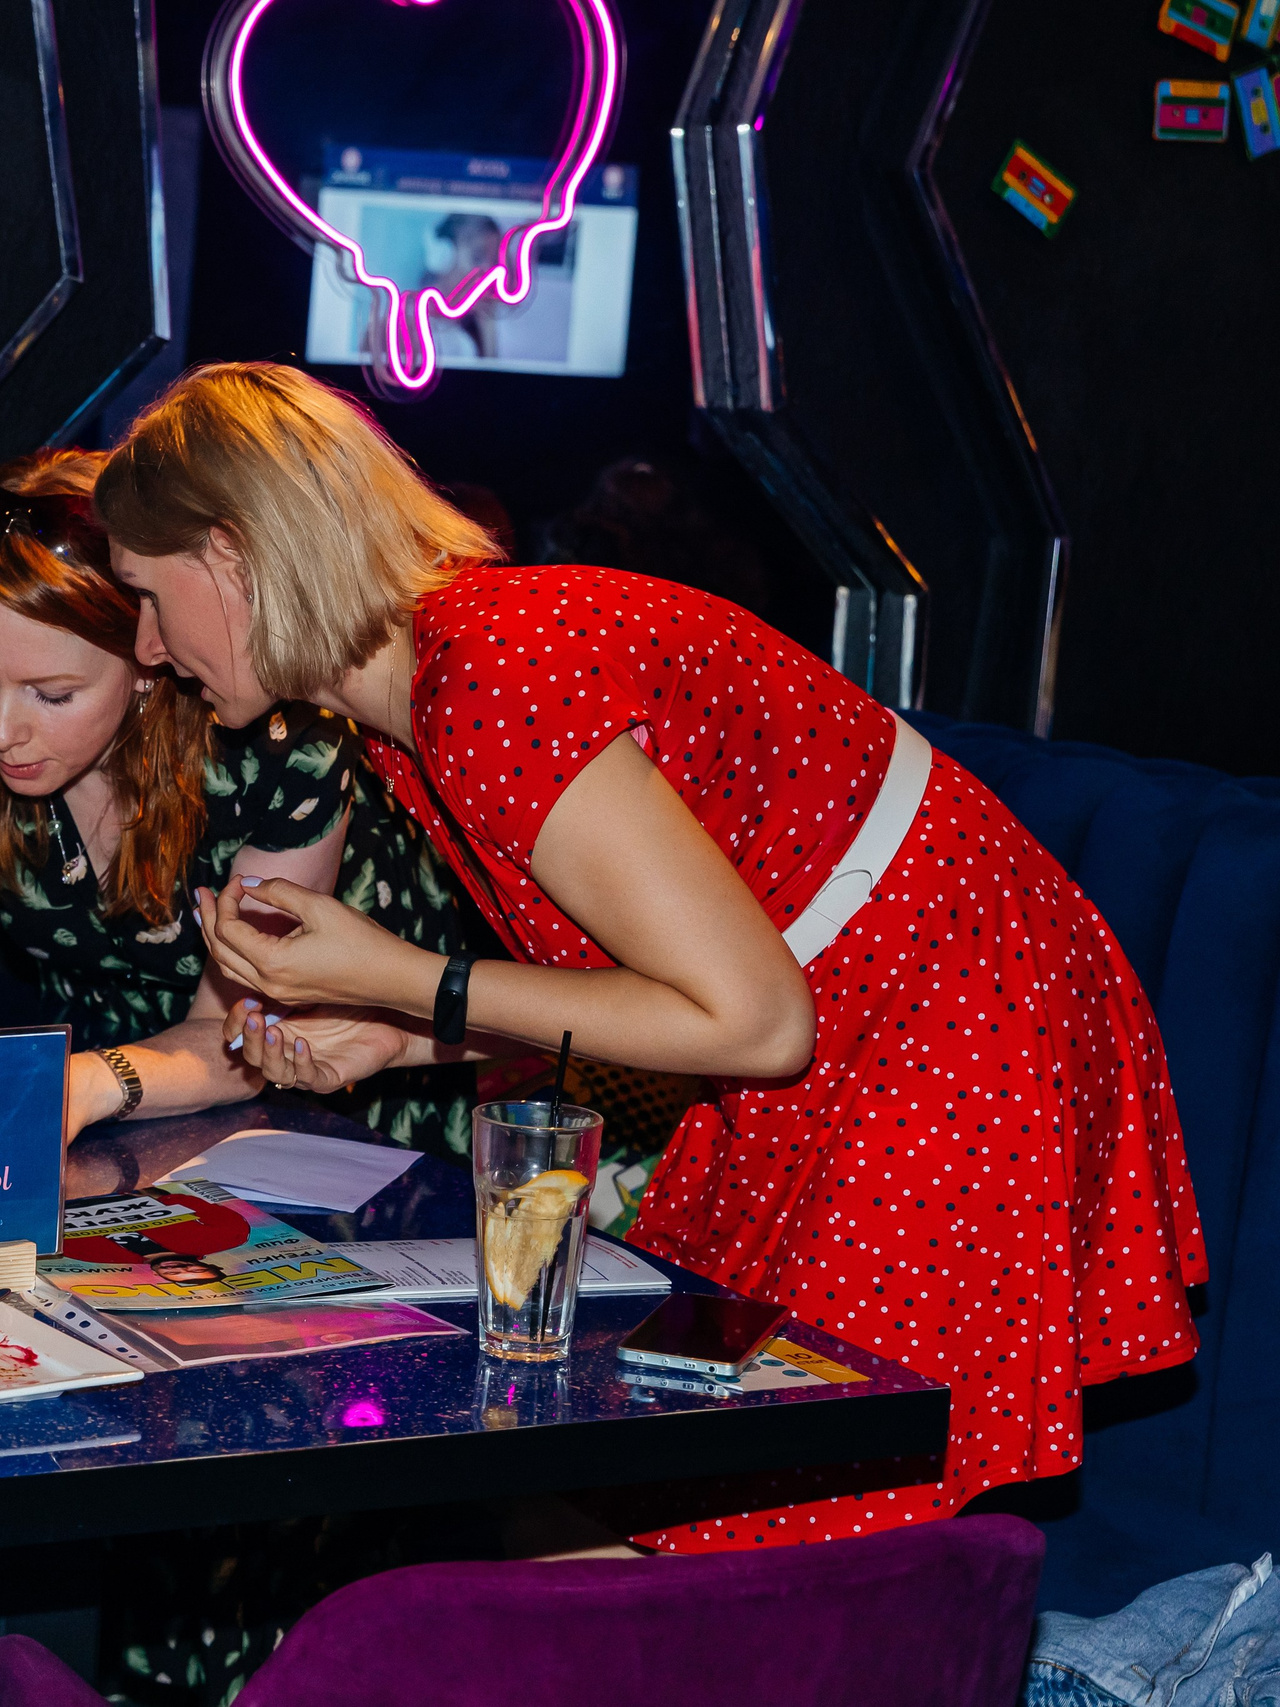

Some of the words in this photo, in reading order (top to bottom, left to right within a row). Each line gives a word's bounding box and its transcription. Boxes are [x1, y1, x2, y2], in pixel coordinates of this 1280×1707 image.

[64, 1201, 155, 1219] ЖУК
[151, 1217, 182, 1226] ЧТО
[254, 1238, 300, 1249] ФИШ
[246, 1249, 324, 1265] ГРЕНКИ
[68, 1257, 362, 1297] МЕНЮ
[293, 1272, 362, 1286] ВЫБИРАЮ
[256, 1284, 292, 1292] РУКИ
